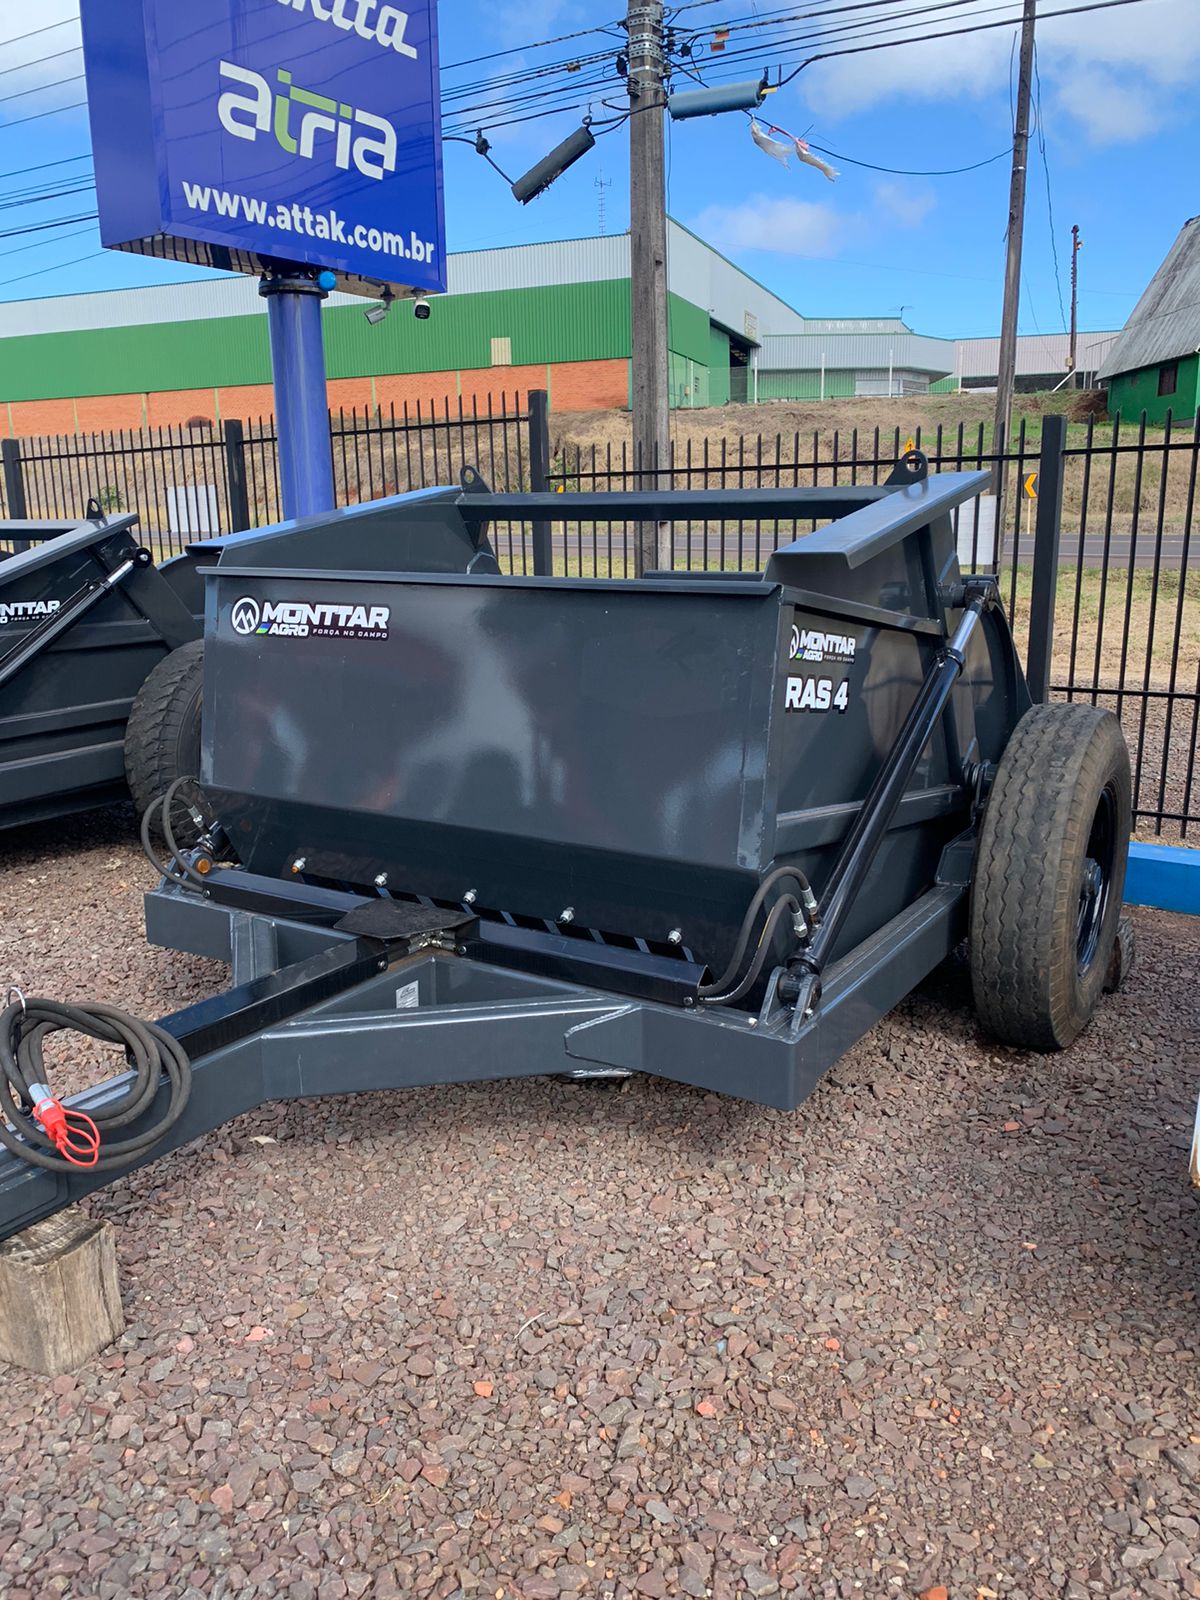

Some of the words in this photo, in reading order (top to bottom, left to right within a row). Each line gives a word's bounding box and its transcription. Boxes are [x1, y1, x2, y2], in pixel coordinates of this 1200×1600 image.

[217, 59, 397, 181] atria
[182, 180, 435, 263] www.attak.com.br
[261, 601, 390, 629] MONTTAR
[268, 623, 309, 637] AGRO
[357, 631, 388, 639] CAMPO
[800, 629, 856, 656] MONTTAR
[802, 649, 823, 662] AGRO
[785, 677, 833, 709] RAS
[833, 681, 849, 710] 4
